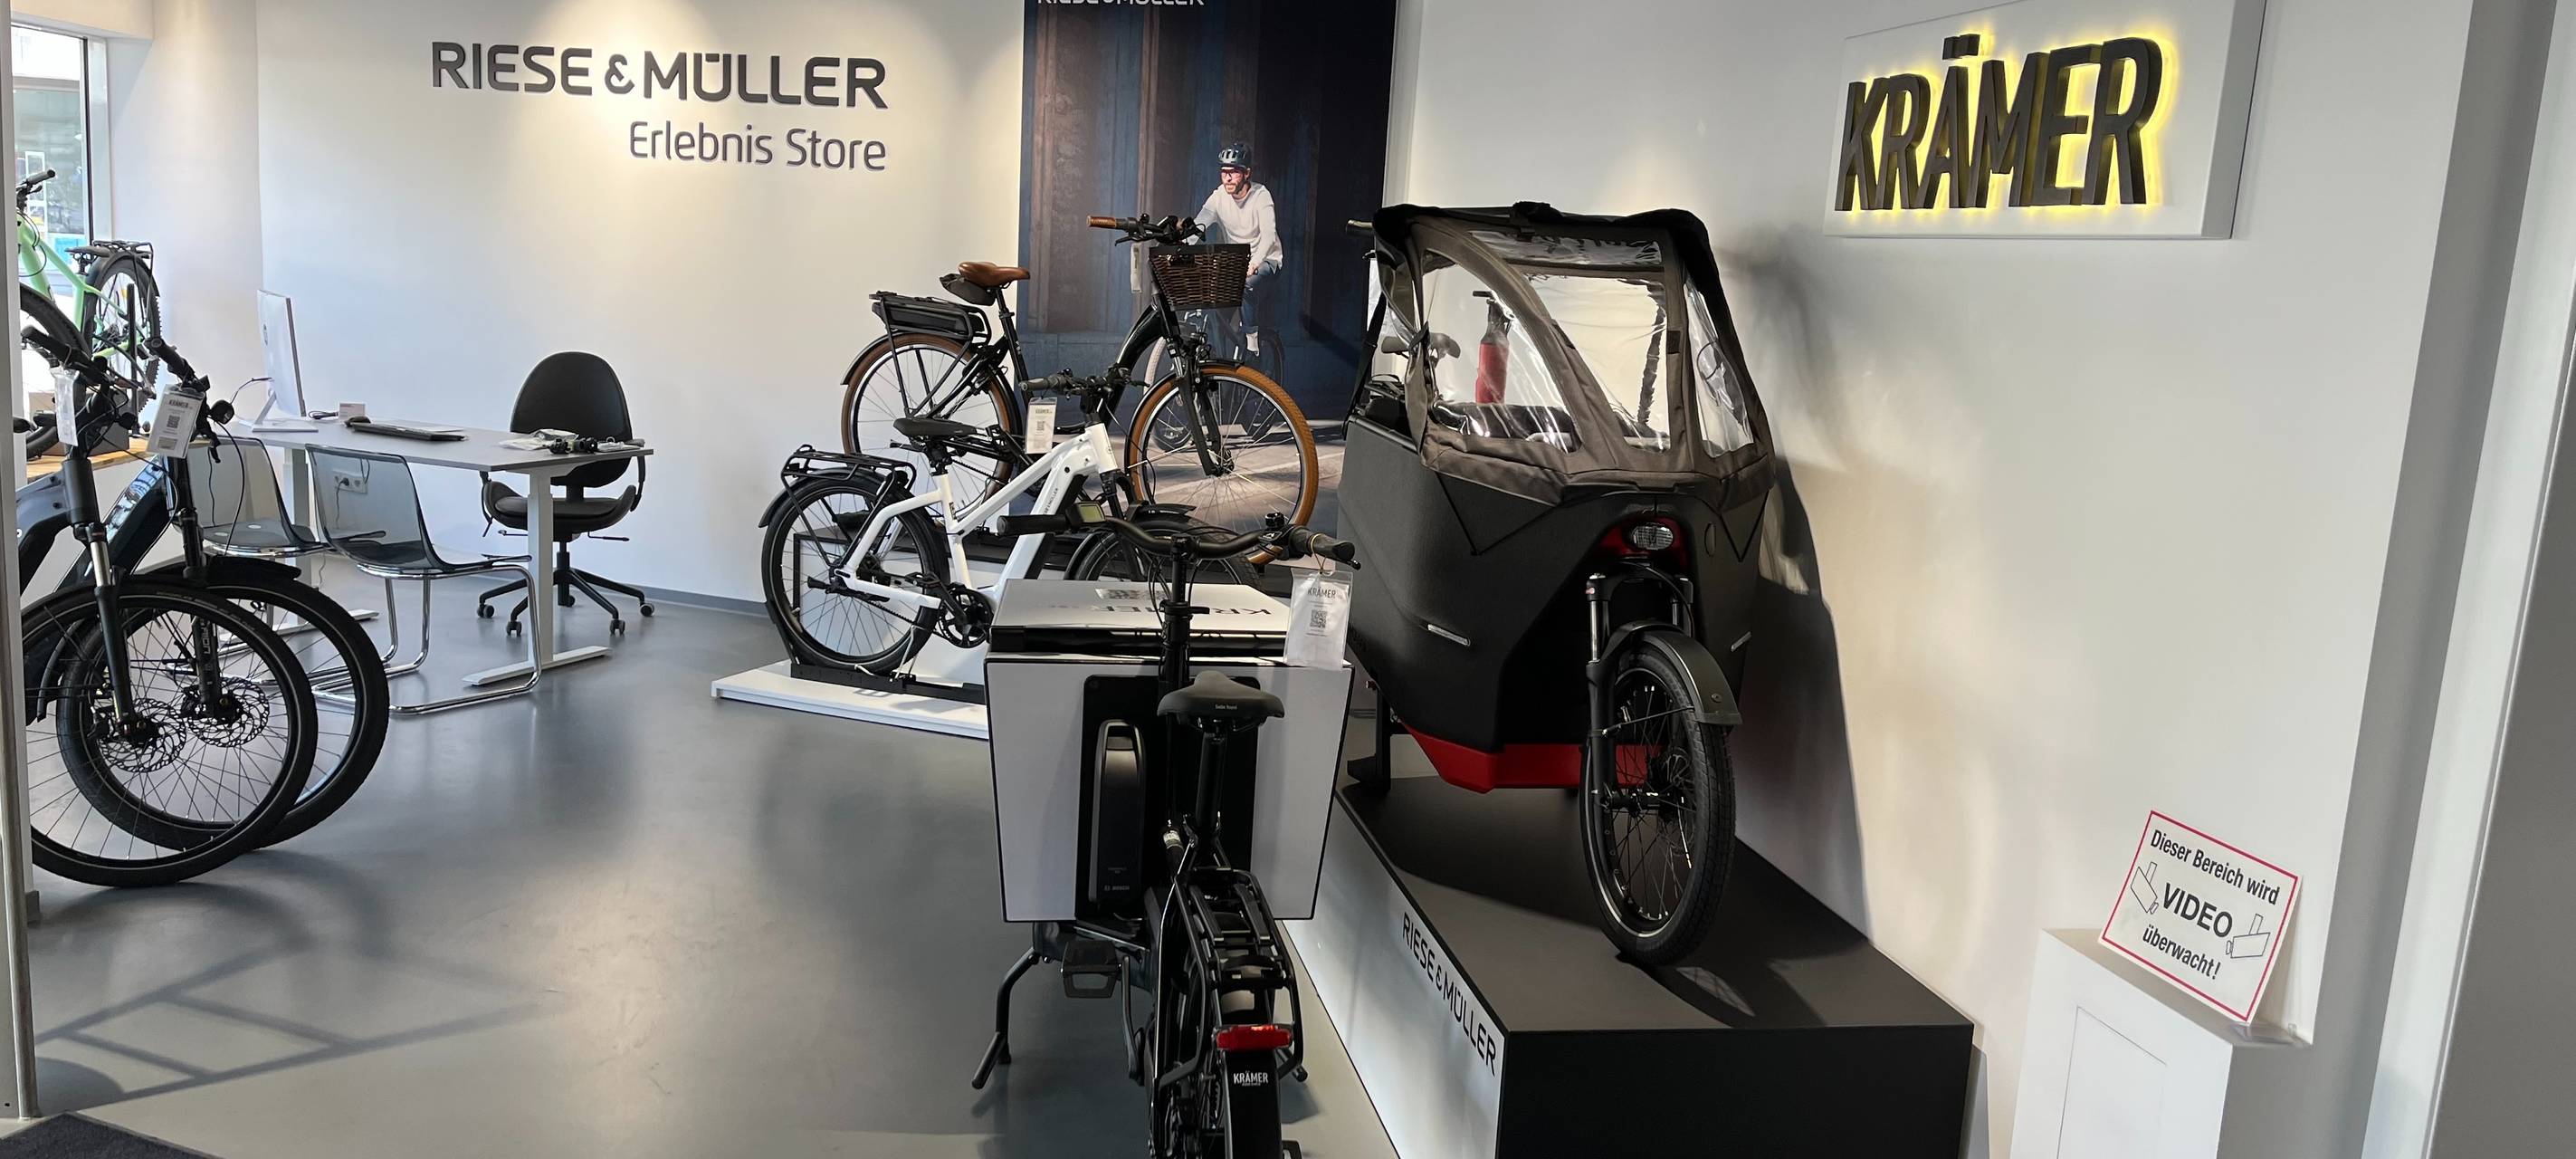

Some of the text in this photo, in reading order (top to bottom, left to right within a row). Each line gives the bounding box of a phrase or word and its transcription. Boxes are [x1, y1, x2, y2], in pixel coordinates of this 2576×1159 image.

[432, 41, 889, 110] RIESE & MÜLLER
[630, 120, 887, 171] Erlebnis Store
[1835, 33, 2163, 212] KRÄMER
[1307, 586, 1336, 599] KRÄMER
[2151, 829, 2281, 905] Dieser Bereich wird
[2163, 882, 2233, 938] VIDEO
[2142, 924, 2221, 981] überwacht!
[1403, 912, 1496, 1077] RIESE & MÜLLER
[1233, 1069, 1269, 1085] KRÄMER
